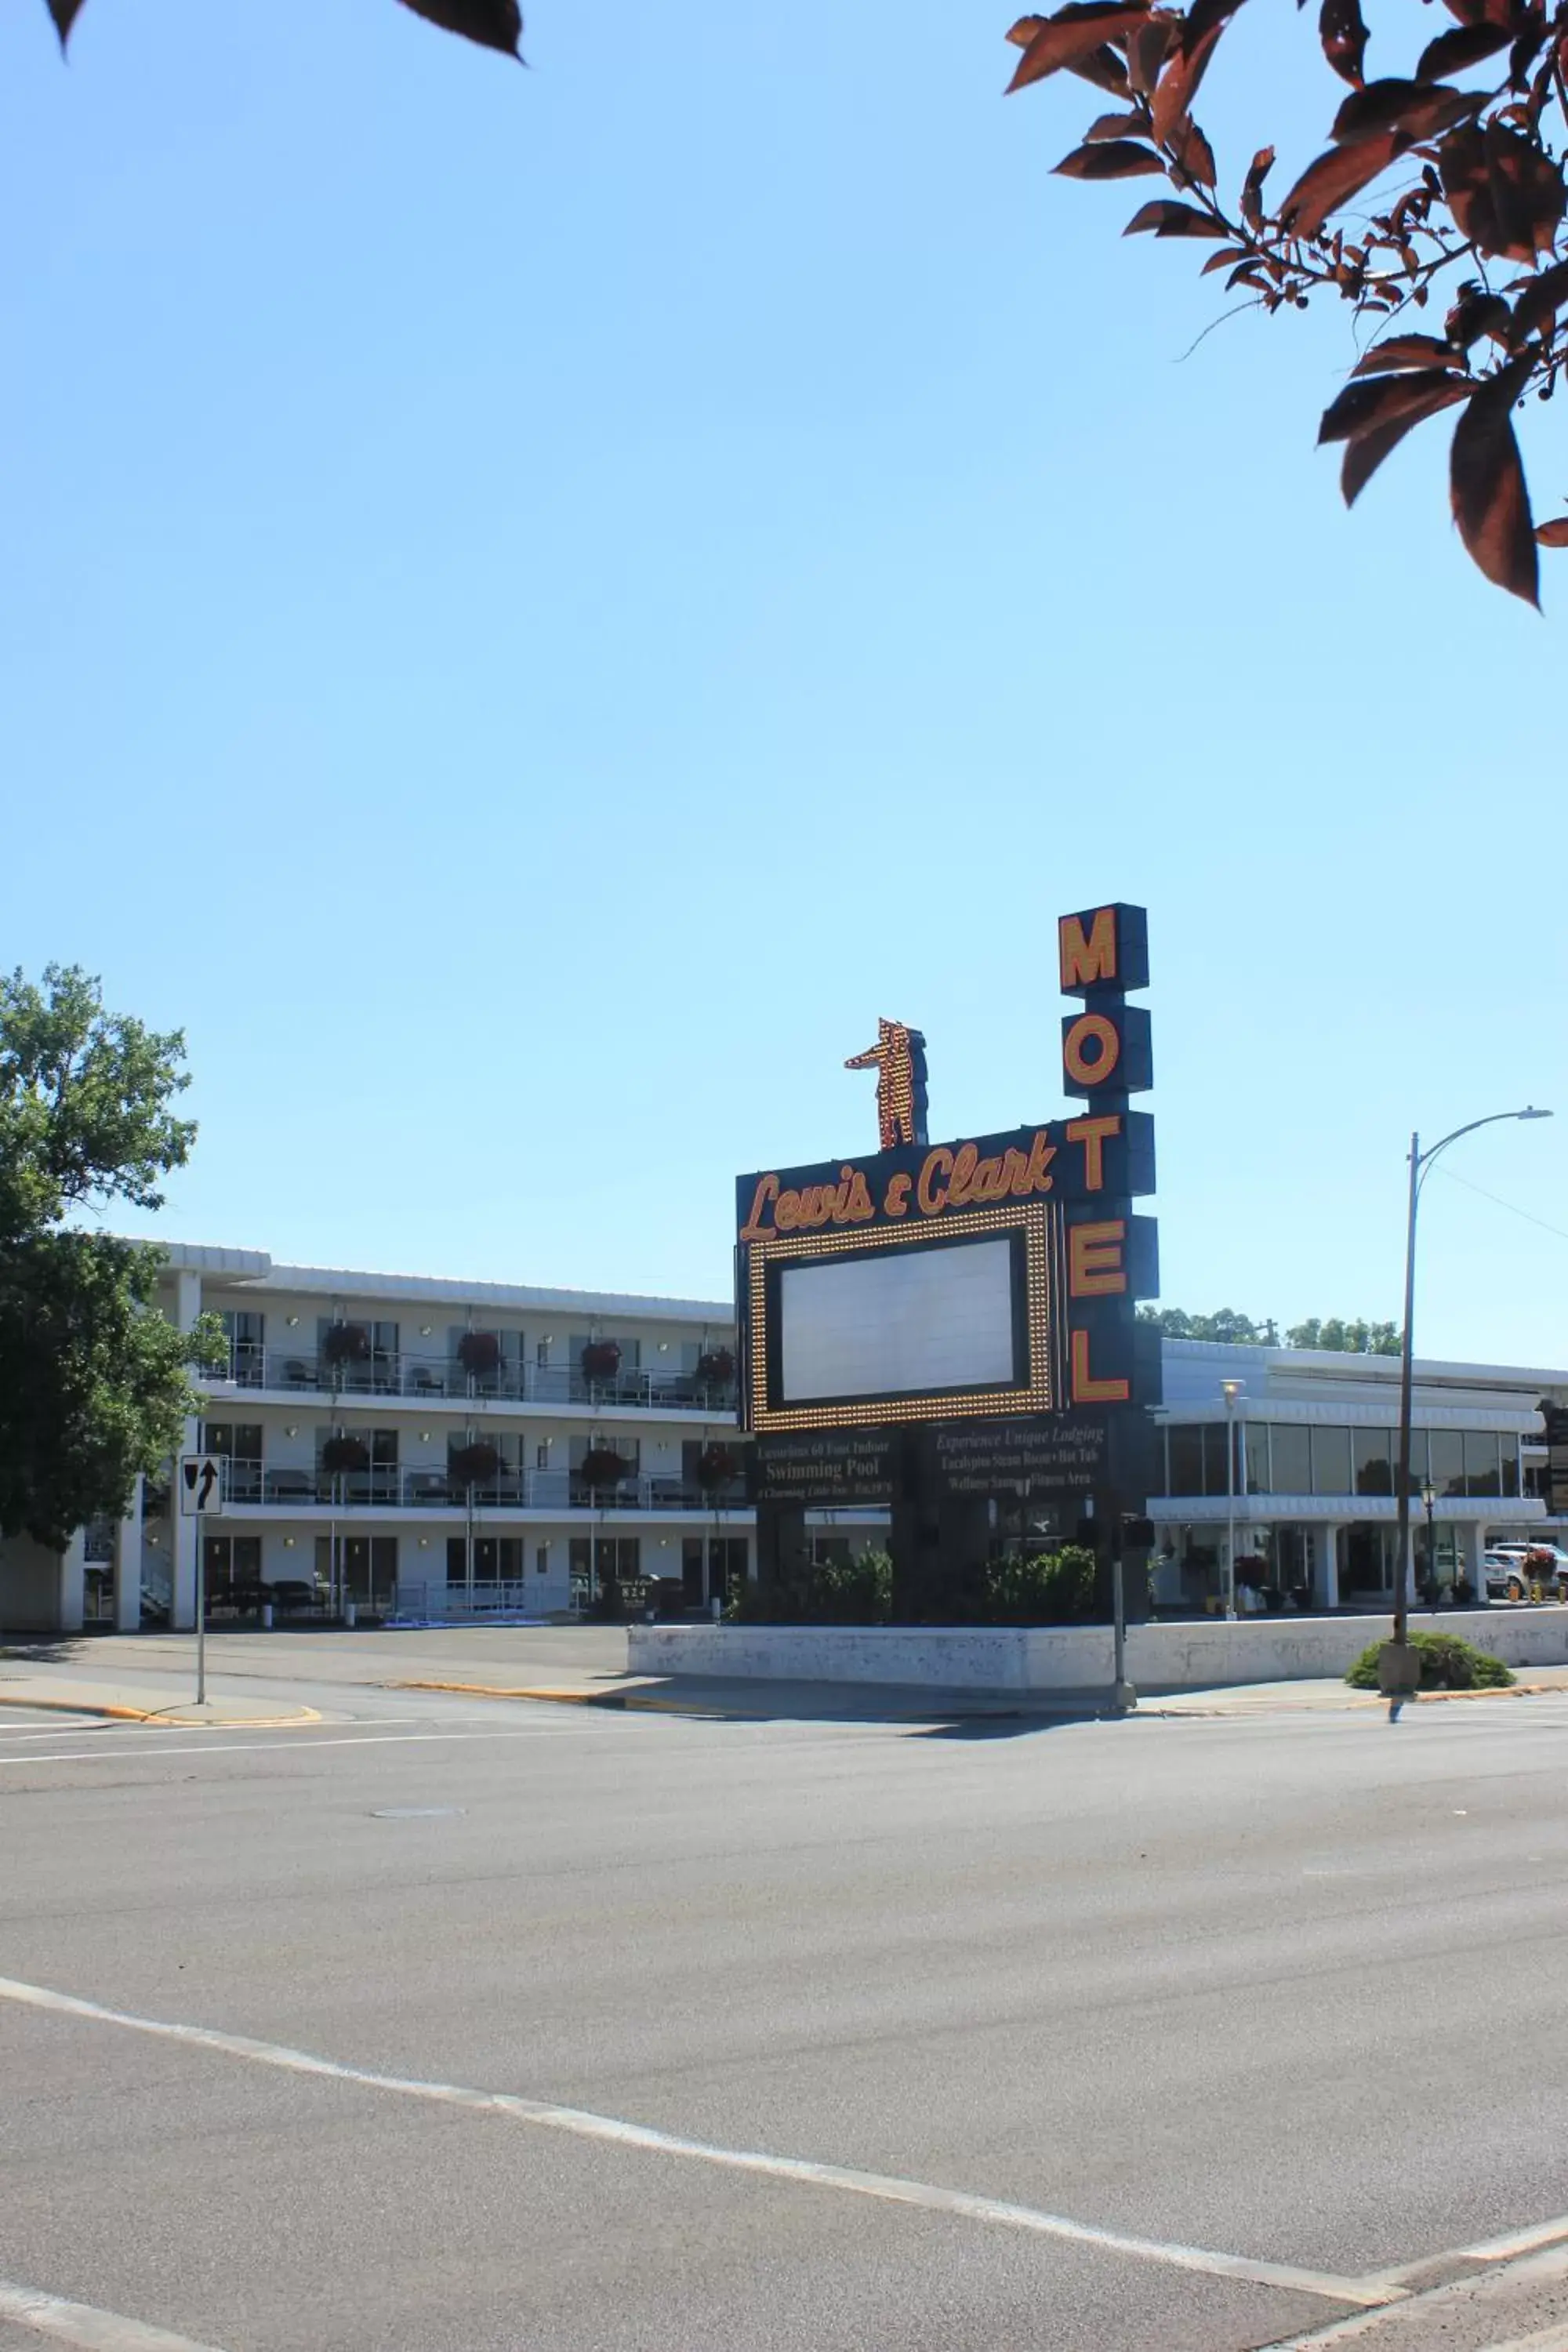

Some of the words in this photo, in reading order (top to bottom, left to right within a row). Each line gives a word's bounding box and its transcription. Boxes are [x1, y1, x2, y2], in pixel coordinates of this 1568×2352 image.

[1058, 907, 1130, 1403] MOTEL
[740, 1165, 876, 1242] Lewis
[884, 1174, 913, 1217] &
[918, 1131, 1058, 1216] Clark
[811, 1443, 824, 1456] 60
[853, 1439, 889, 1455] Indoor
[936, 1430, 1002, 1453] Experience
[1004, 1427, 1050, 1448] Unique
[1052, 1425, 1105, 1446] Lodging
[766, 1459, 843, 1482] Swimming
[846, 1455, 880, 1477] Pool
